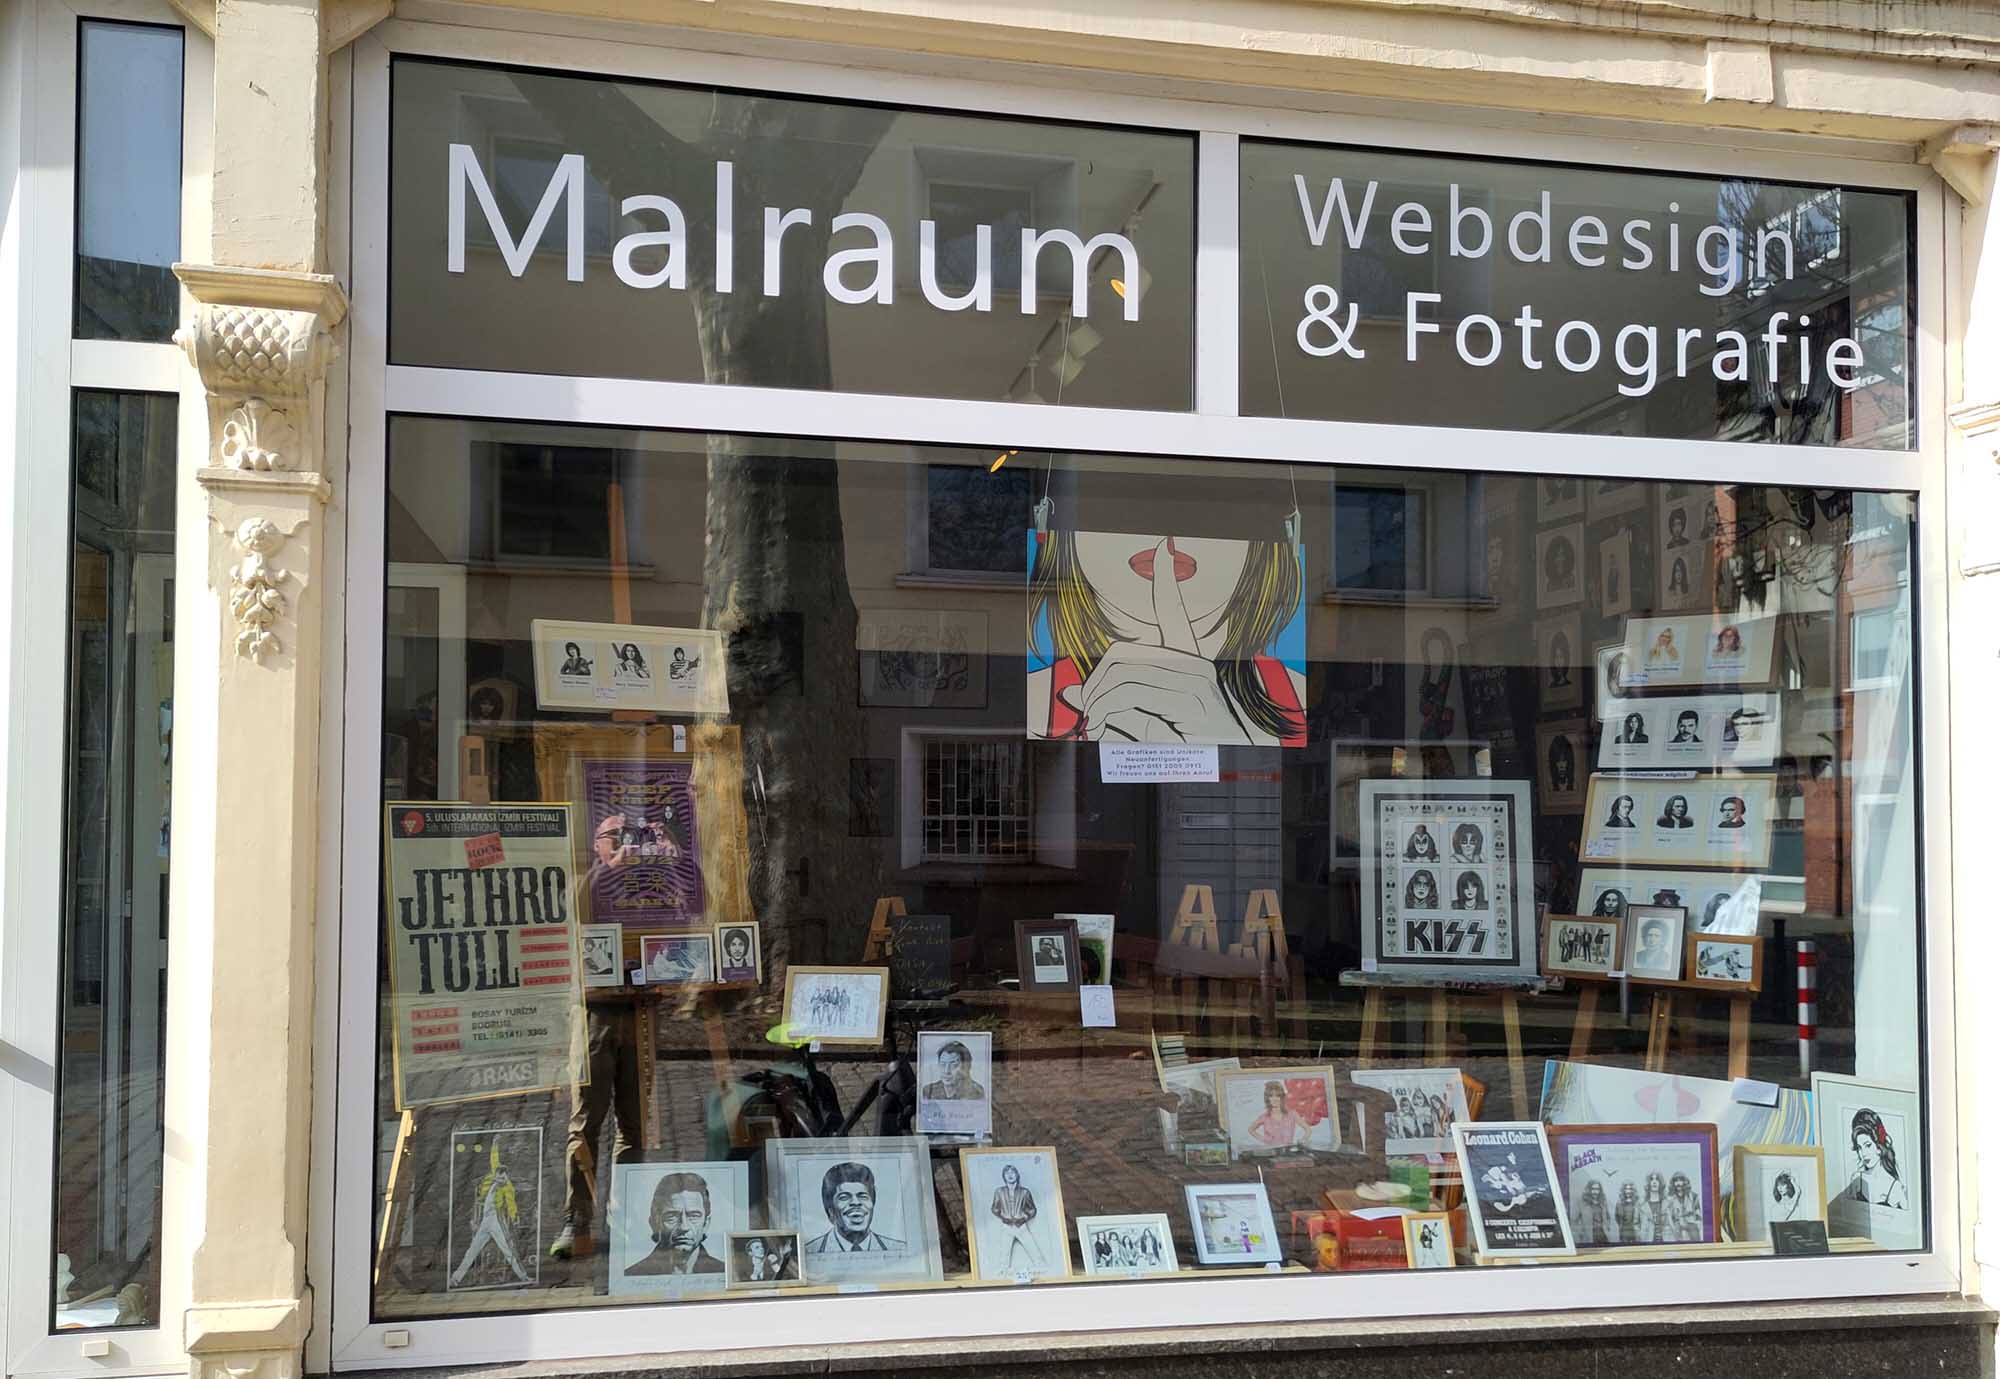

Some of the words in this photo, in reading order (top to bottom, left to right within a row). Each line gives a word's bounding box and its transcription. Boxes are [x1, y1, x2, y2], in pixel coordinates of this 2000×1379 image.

[447, 143, 1140, 322] Malraum
[1293, 173, 1794, 297] Webdesign
[1296, 283, 1366, 360] &
[1405, 290, 1866, 397] Fotografie
[398, 865, 568, 931] JETHRO
[409, 929, 521, 995] TULL
[1404, 918, 1490, 955] KISS
[1463, 1131, 1510, 1147] Leonard
[1508, 1130, 1539, 1146] Cohen
